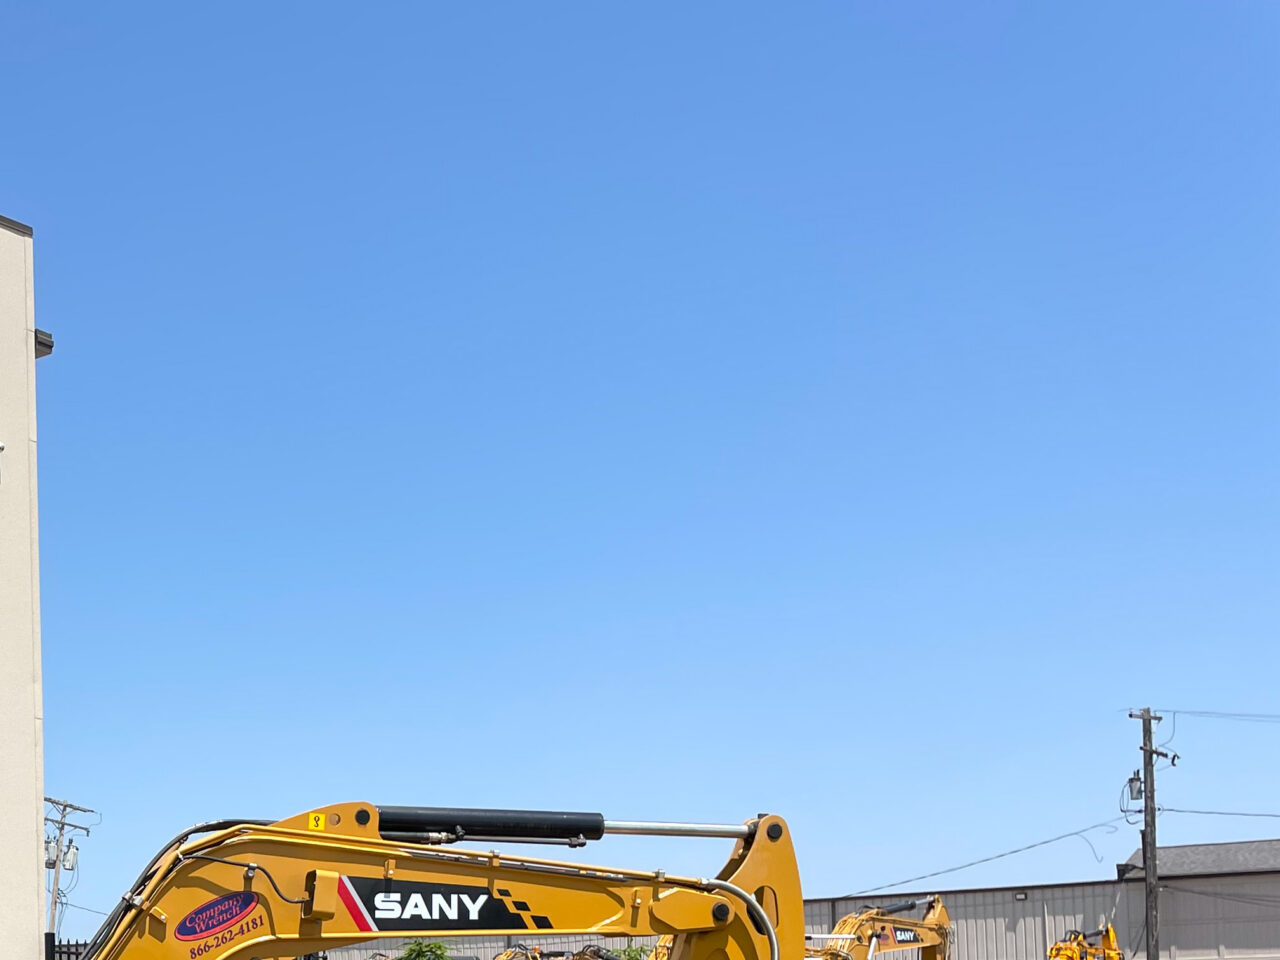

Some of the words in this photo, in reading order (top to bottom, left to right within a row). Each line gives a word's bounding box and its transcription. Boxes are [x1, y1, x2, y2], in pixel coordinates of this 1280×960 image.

[185, 894, 244, 928] Company
[194, 904, 241, 933] Wrench
[374, 892, 489, 920] SANY
[189, 914, 265, 960] 866-262-4181
[895, 930, 915, 941] SANY
